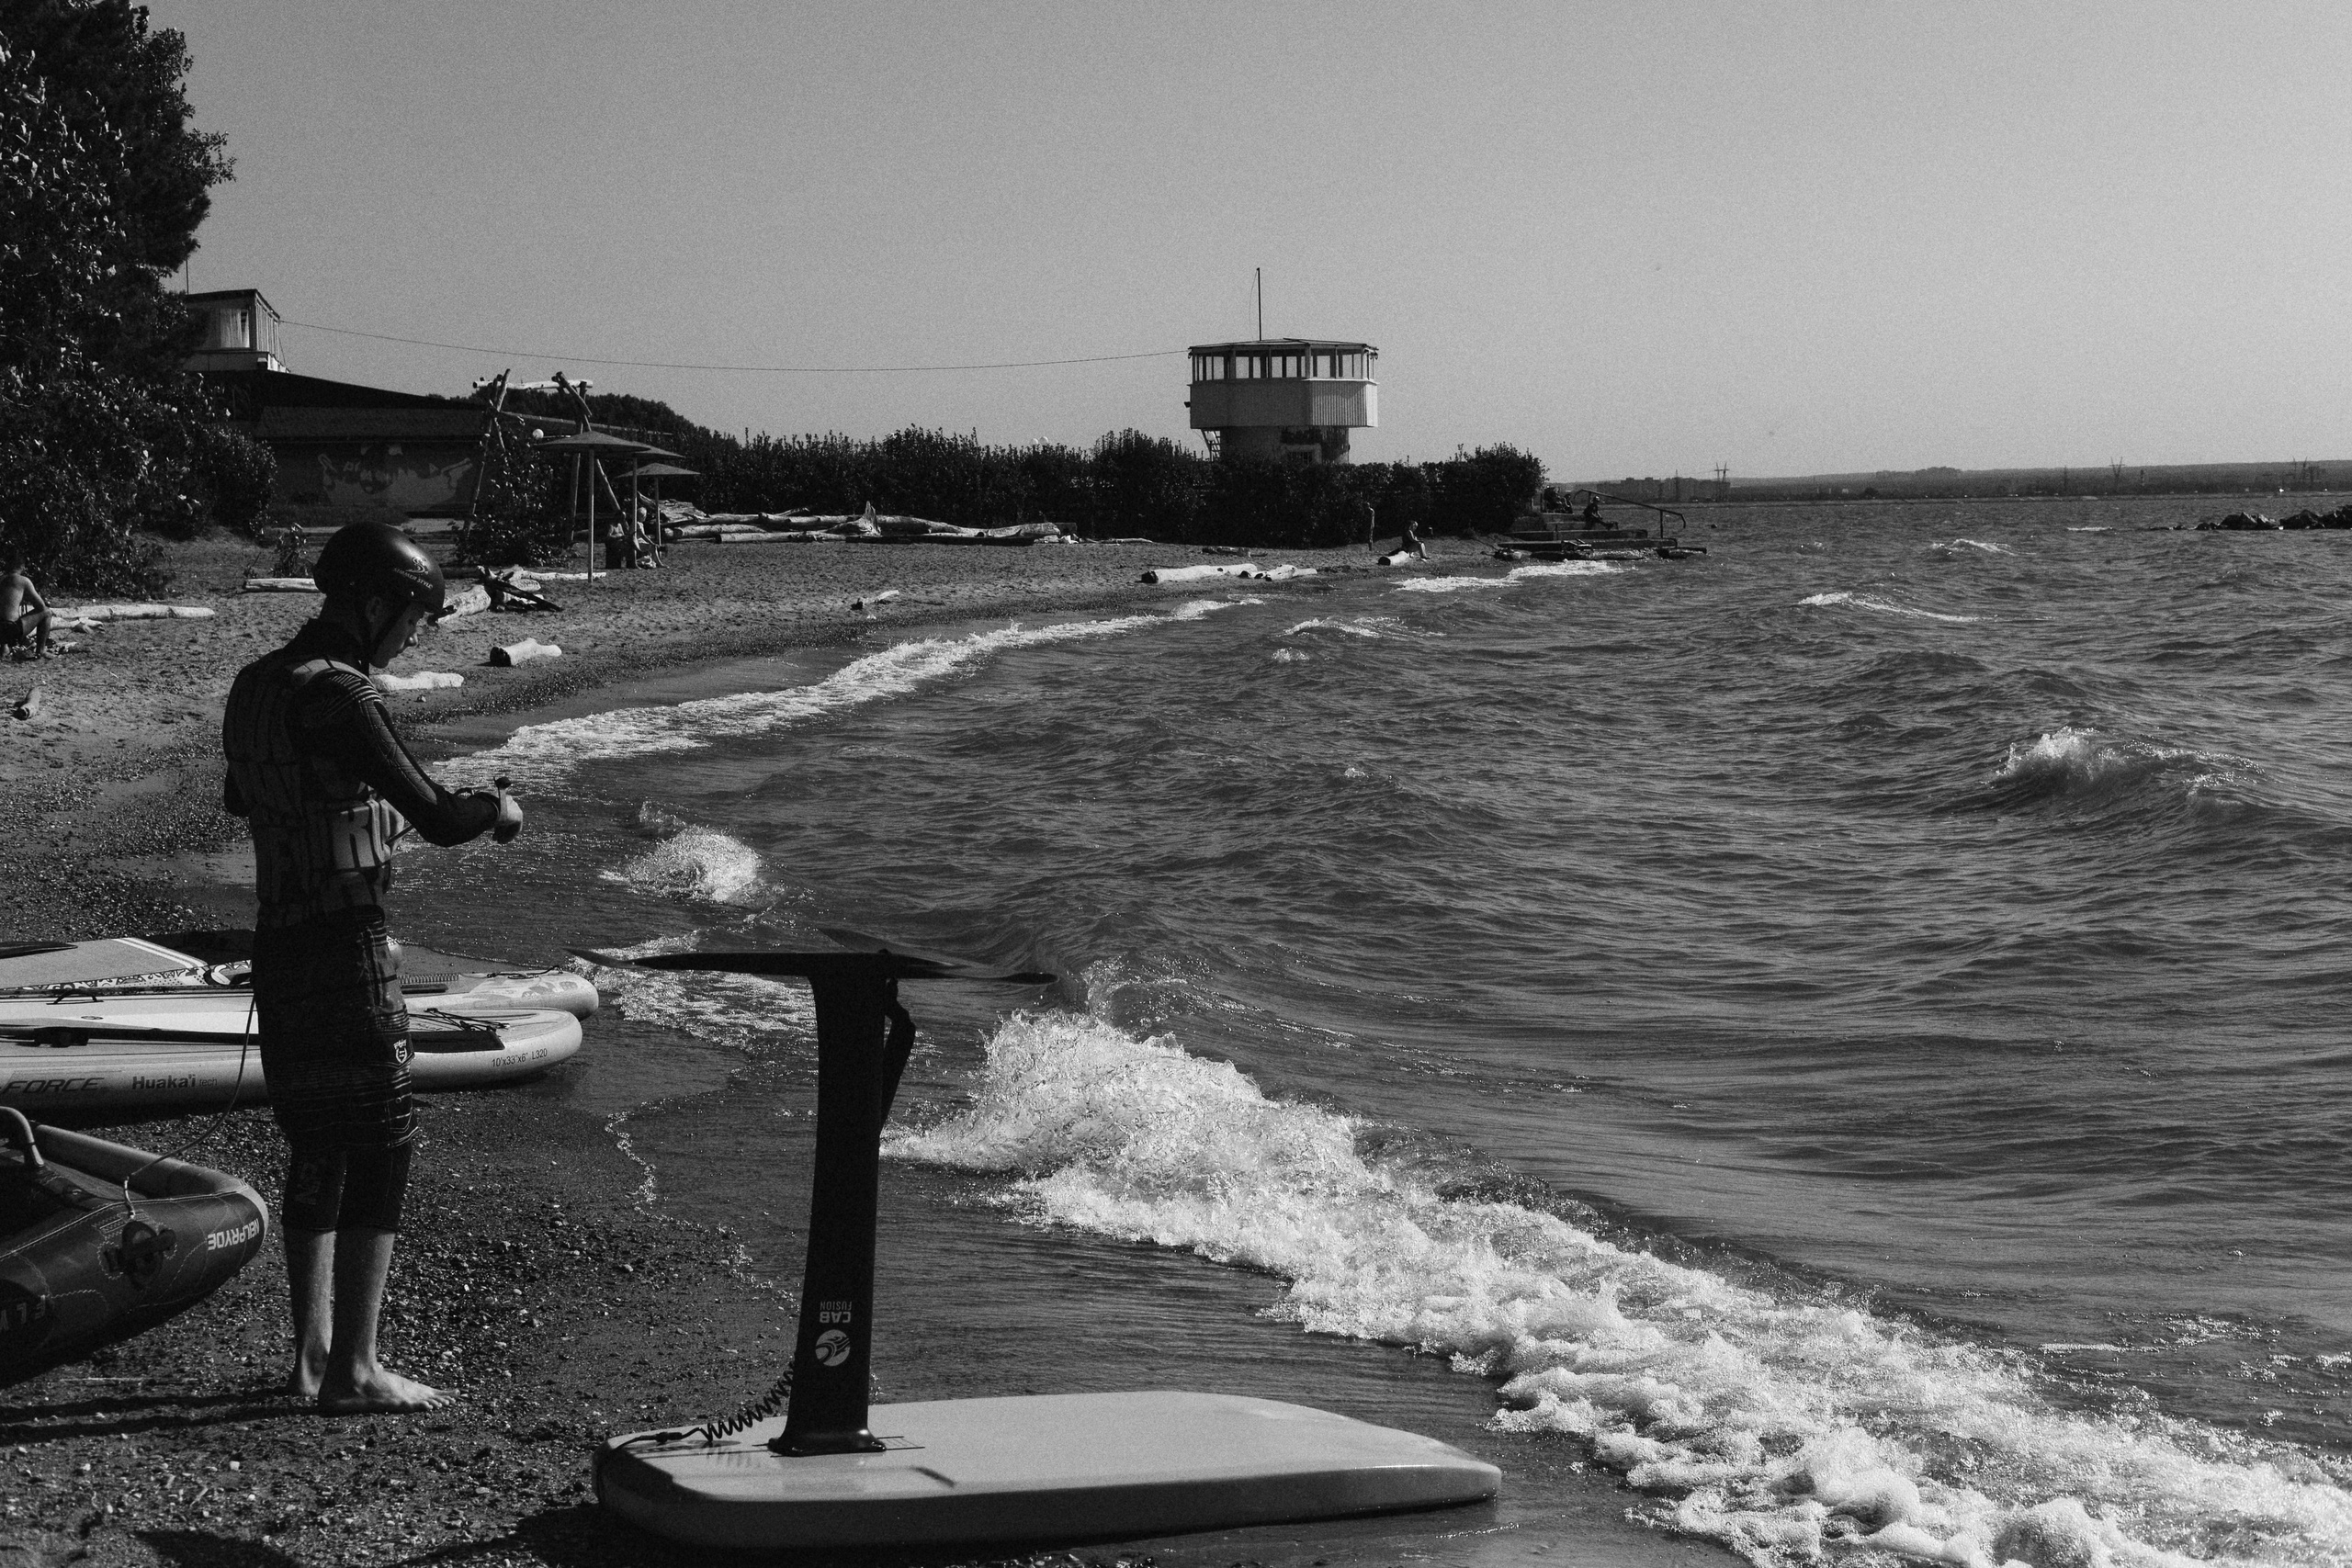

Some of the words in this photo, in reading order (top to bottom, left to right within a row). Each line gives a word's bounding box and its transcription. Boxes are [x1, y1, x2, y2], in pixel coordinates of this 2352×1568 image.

[532, 1048, 548, 1060] L320
[2, 1077, 105, 1094] FORCE
[132, 1074, 196, 1089] Huaka'i
[198, 1077, 218, 1088] tech
[207, 1217, 260, 1251] NEILPRYDE
[820, 1301, 853, 1311] FUSION
[819, 1311, 852, 1324] CAB
